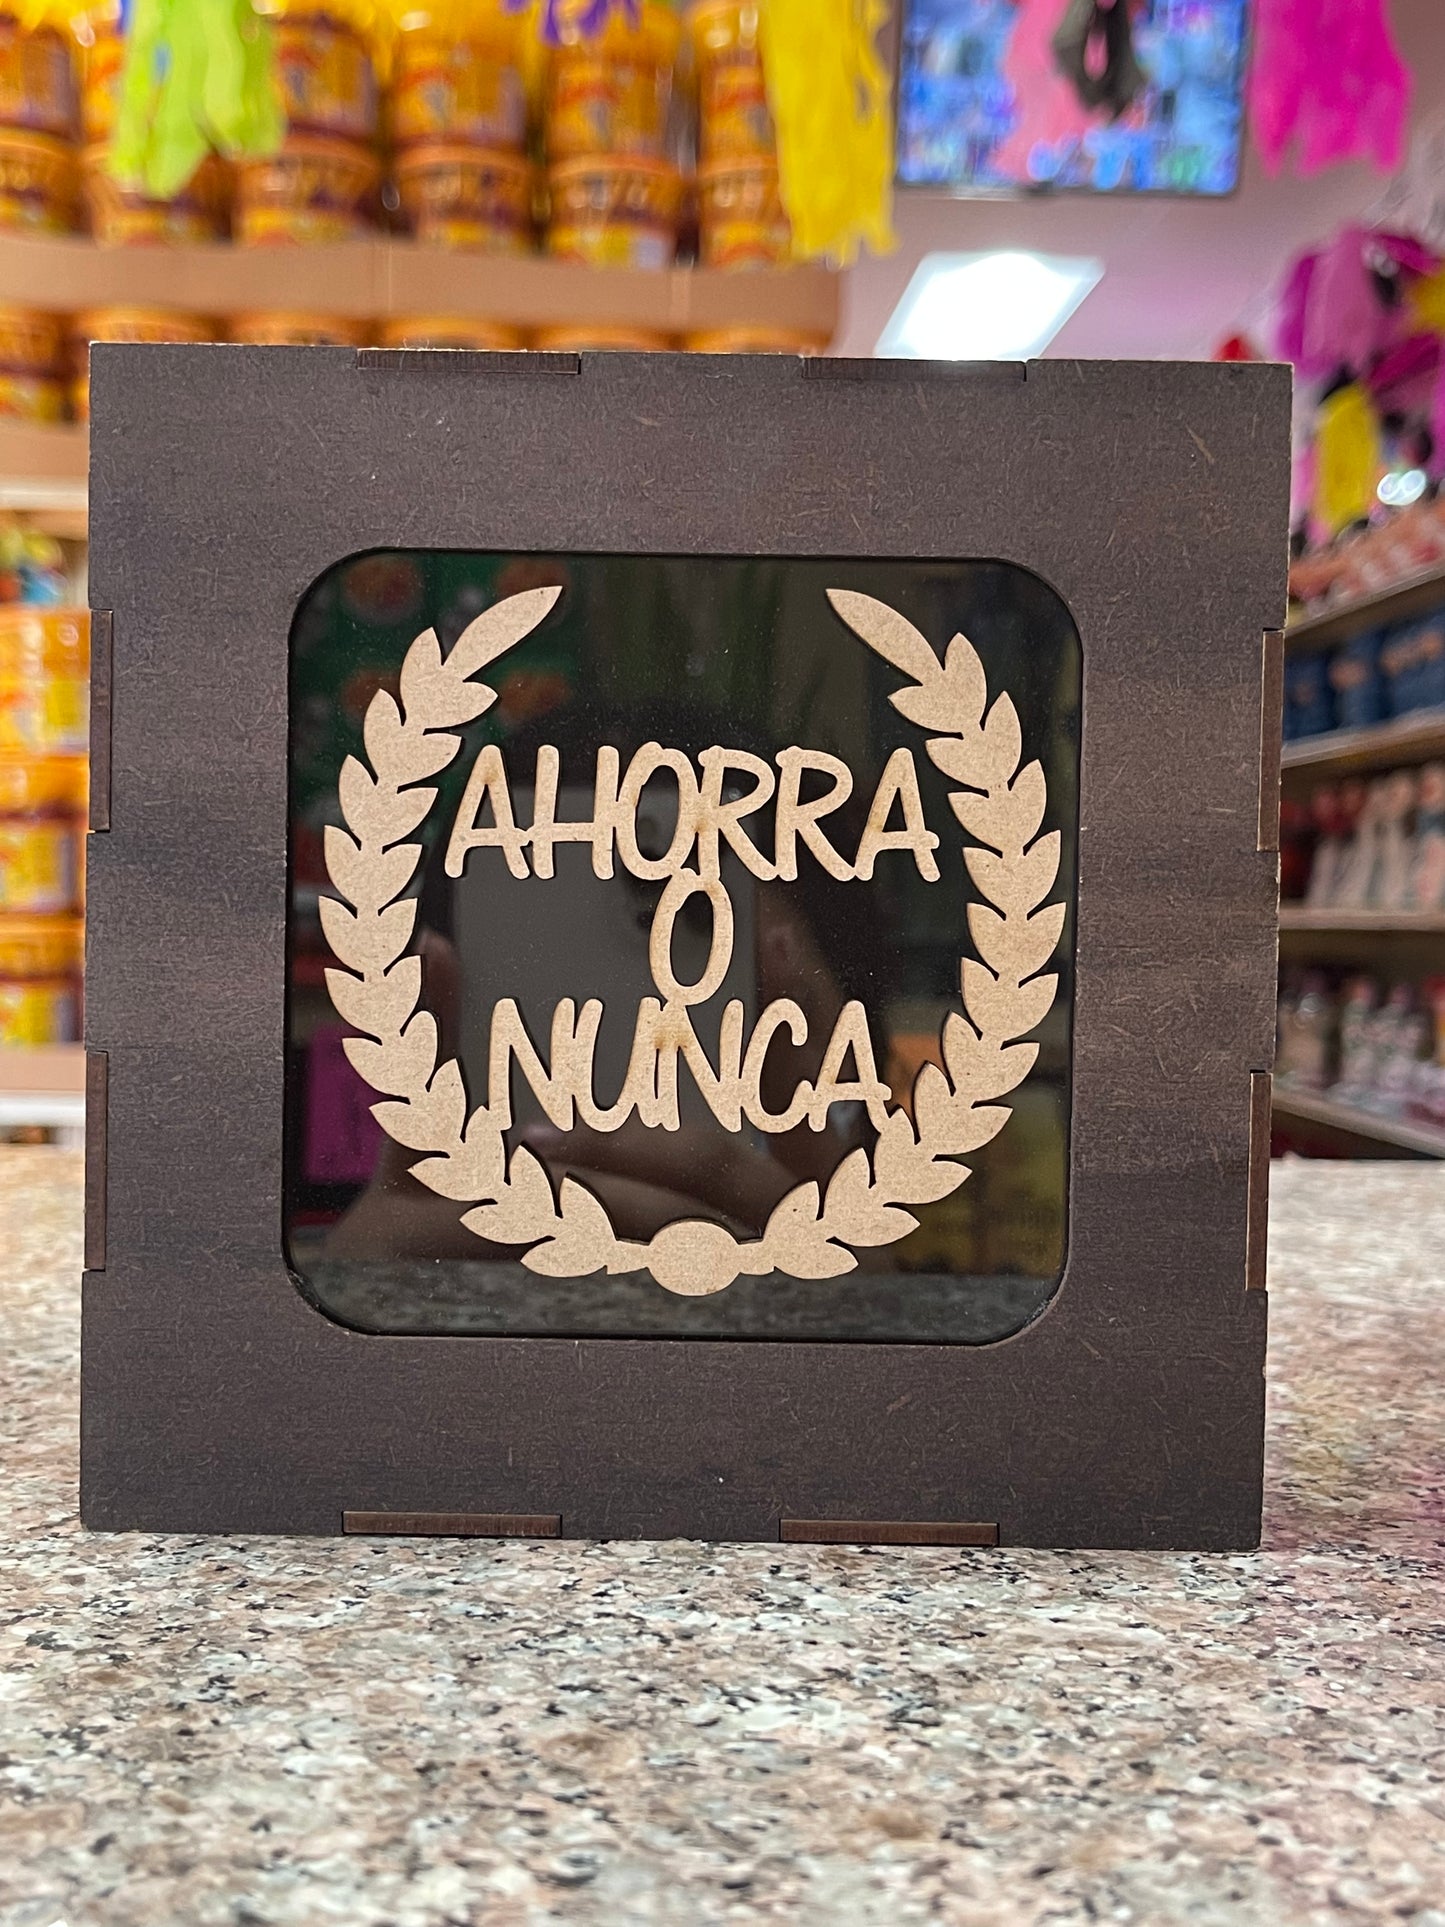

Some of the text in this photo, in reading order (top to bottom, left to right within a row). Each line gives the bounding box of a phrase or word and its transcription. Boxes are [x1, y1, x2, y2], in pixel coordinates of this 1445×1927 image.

[444, 741, 941, 882] AHORRA
[649, 868, 734, 1006] O
[488, 997, 892, 1133] NUNCA
